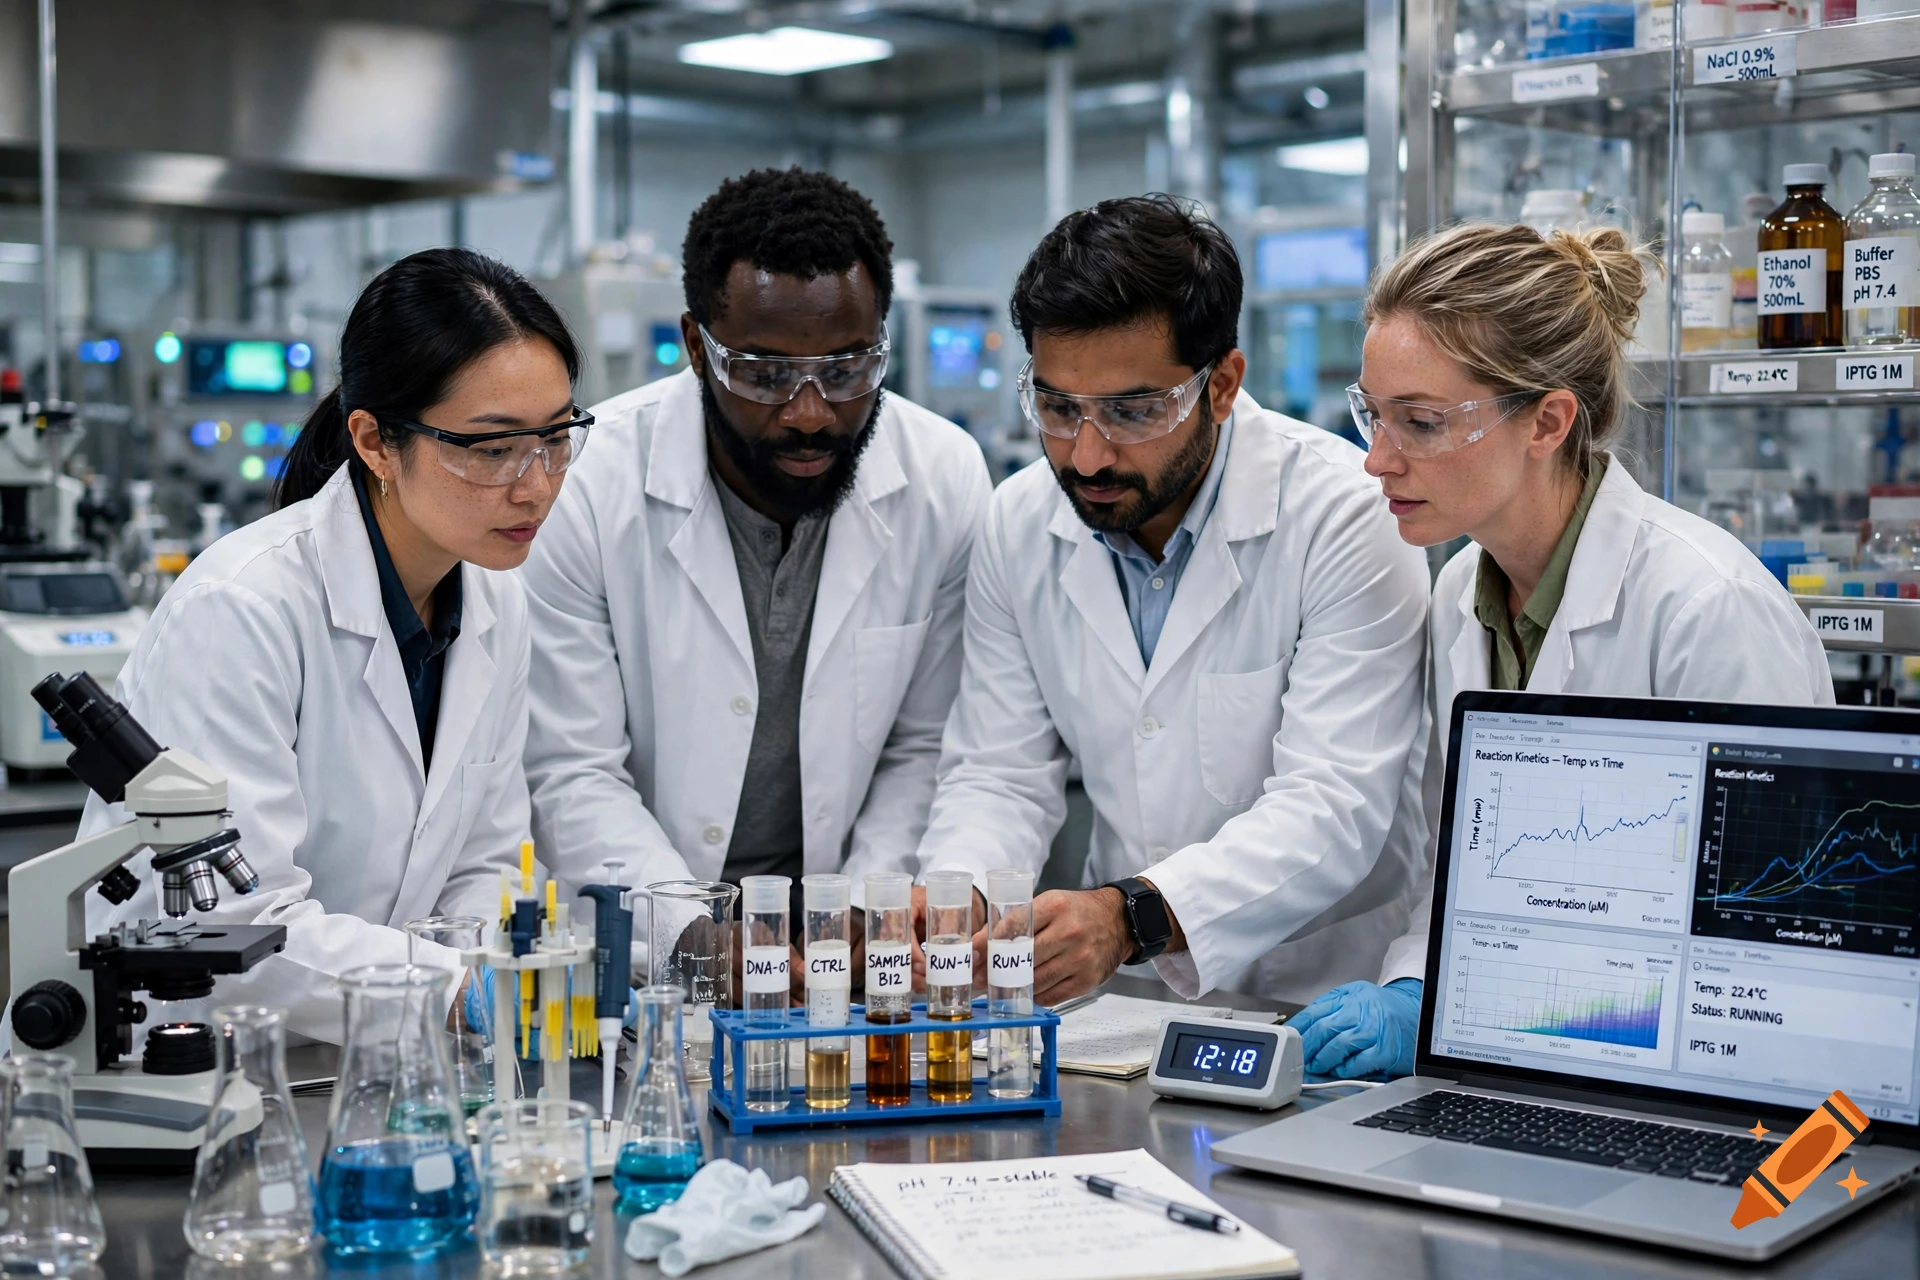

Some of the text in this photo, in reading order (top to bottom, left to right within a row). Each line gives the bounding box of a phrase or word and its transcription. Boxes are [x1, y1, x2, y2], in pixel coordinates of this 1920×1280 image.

[1707, 46, 1775, 69] NaCl 0.9%
[1738, 63, 1777, 81] 500mL
[1855, 246, 1894, 262] Buffer
[1763, 255, 1811, 271] Ethanol
[1768, 275, 1796, 289] 70%
[1855, 266, 1881, 281] PBS
[1763, 292, 1805, 307] 500mL
[1853, 284, 1897, 303] pH 7.4
[1845, 364, 1902, 380] IPTG 1M
[1818, 615, 1872, 632] IPTG 1M
[1475, 749, 1513, 762] Reaction
[1515, 751, 1550, 764] Kinetics
[1562, 755, 1587, 769] Temp
[1589, 758, 1599, 767] vs
[1602, 757, 1625, 769] Time
[1469, 826, 1480, 851] Time
[1526, 894, 1609, 914] Concentration (μM)
[811, 958, 846, 973] CTRL
[868, 953, 911, 968] SAMPLE
[930, 953, 971, 970] RUN-4
[992, 952, 1032, 969] RUN-4
[878, 972, 903, 987] B12
[1694, 980, 1768, 1001] Temp: 22.4°C
[1691, 1002, 1783, 1025] Status: RUNNING
[1689, 1039, 1737, 1057] IPTG 1M
[1193, 1044, 1257, 1074] 12:18
[898, 1177, 925, 1191] pH
[940, 1175, 977, 1187] 7.4
